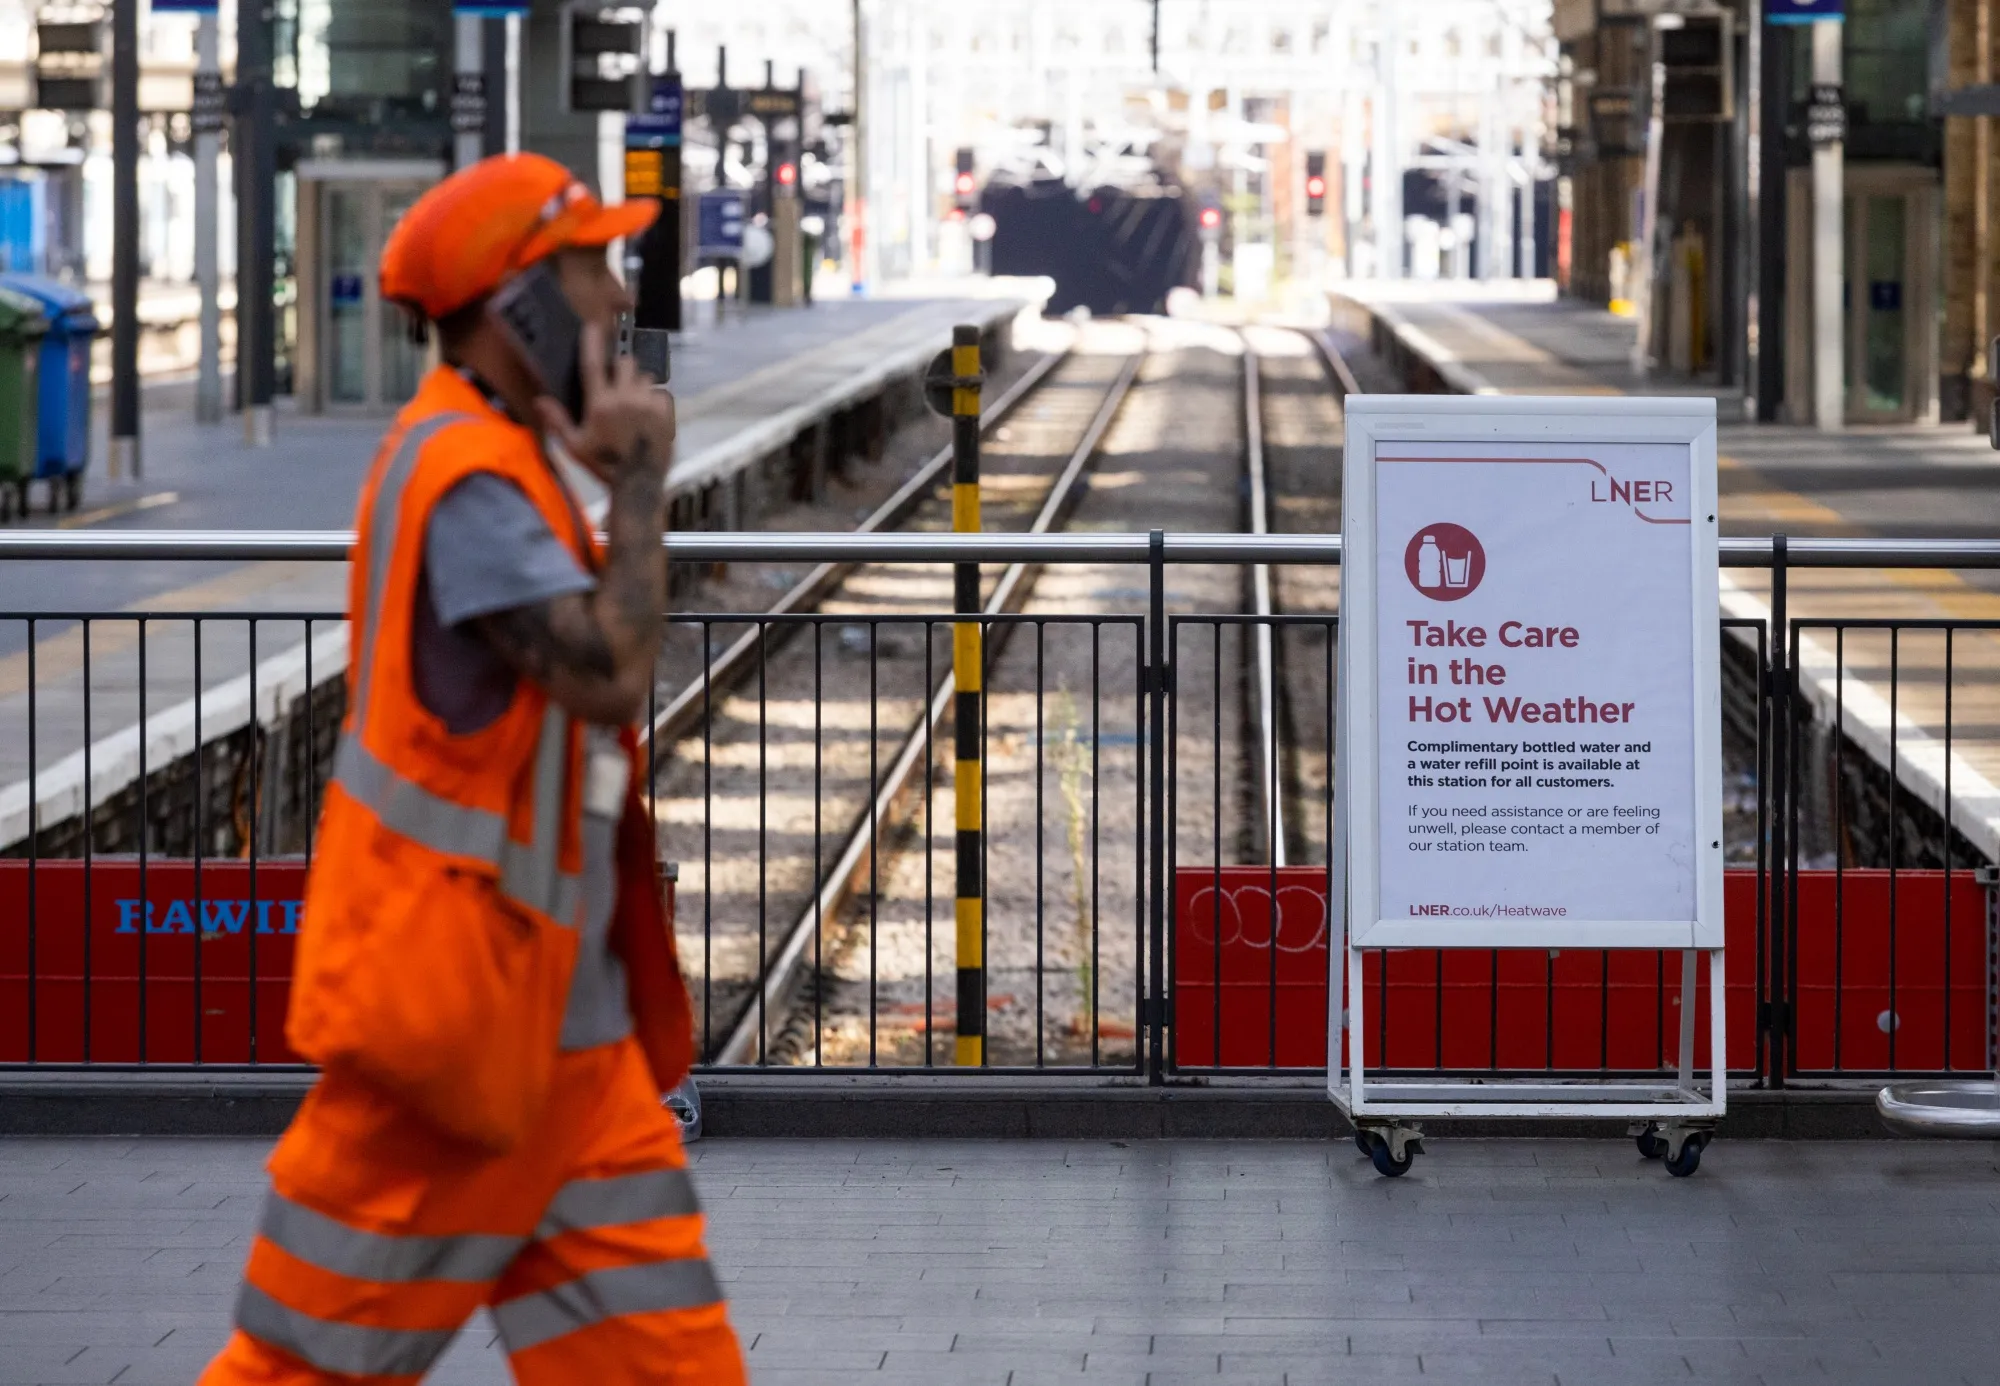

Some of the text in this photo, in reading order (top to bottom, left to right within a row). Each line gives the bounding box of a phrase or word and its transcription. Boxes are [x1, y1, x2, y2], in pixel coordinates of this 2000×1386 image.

[1592, 476, 1673, 506] LNER
[1406, 620, 1579, 648] Take Care
[1408, 657, 1506, 685] in the
[1409, 696, 1635, 723] Hot Weather
[1408, 740, 1651, 755] Complimentary bottled water and
[1408, 757, 1640, 772] a water refill point is available at
[1408, 774, 1614, 787] this station for all customers.
[1409, 804, 1660, 819] If you need assistance or are feeling
[1409, 821, 1660, 836] unwell, please contact a member of
[1409, 839, 1528, 851] our station team.
[1410, 903, 1566, 917] LNER.co.uk/Heatwave
